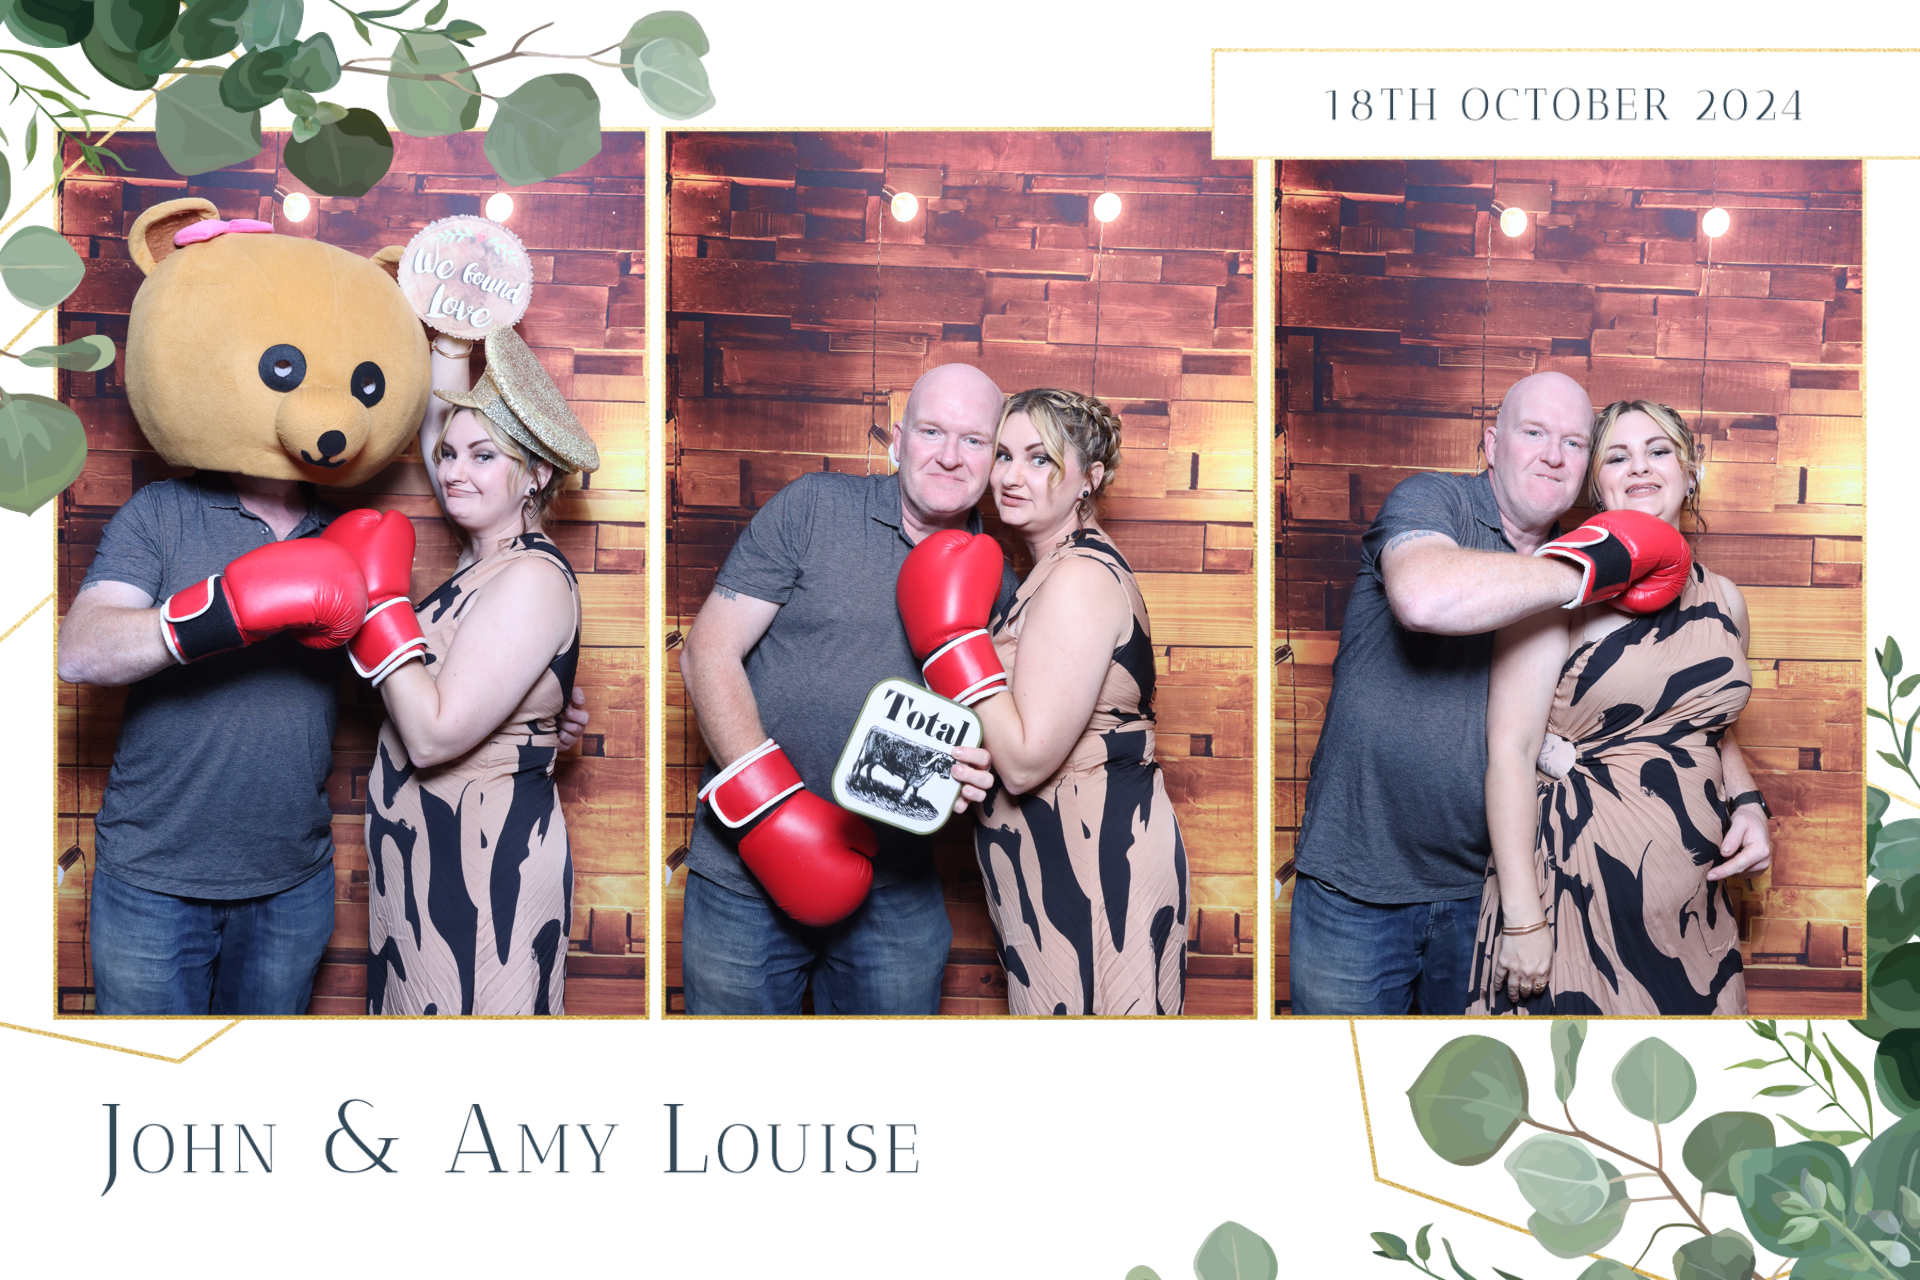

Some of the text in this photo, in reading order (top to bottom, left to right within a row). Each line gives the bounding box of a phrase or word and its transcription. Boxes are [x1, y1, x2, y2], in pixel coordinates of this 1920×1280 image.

[413, 243, 525, 305] We found
[425, 283, 493, 328] Love
[883, 688, 971, 747] Total
